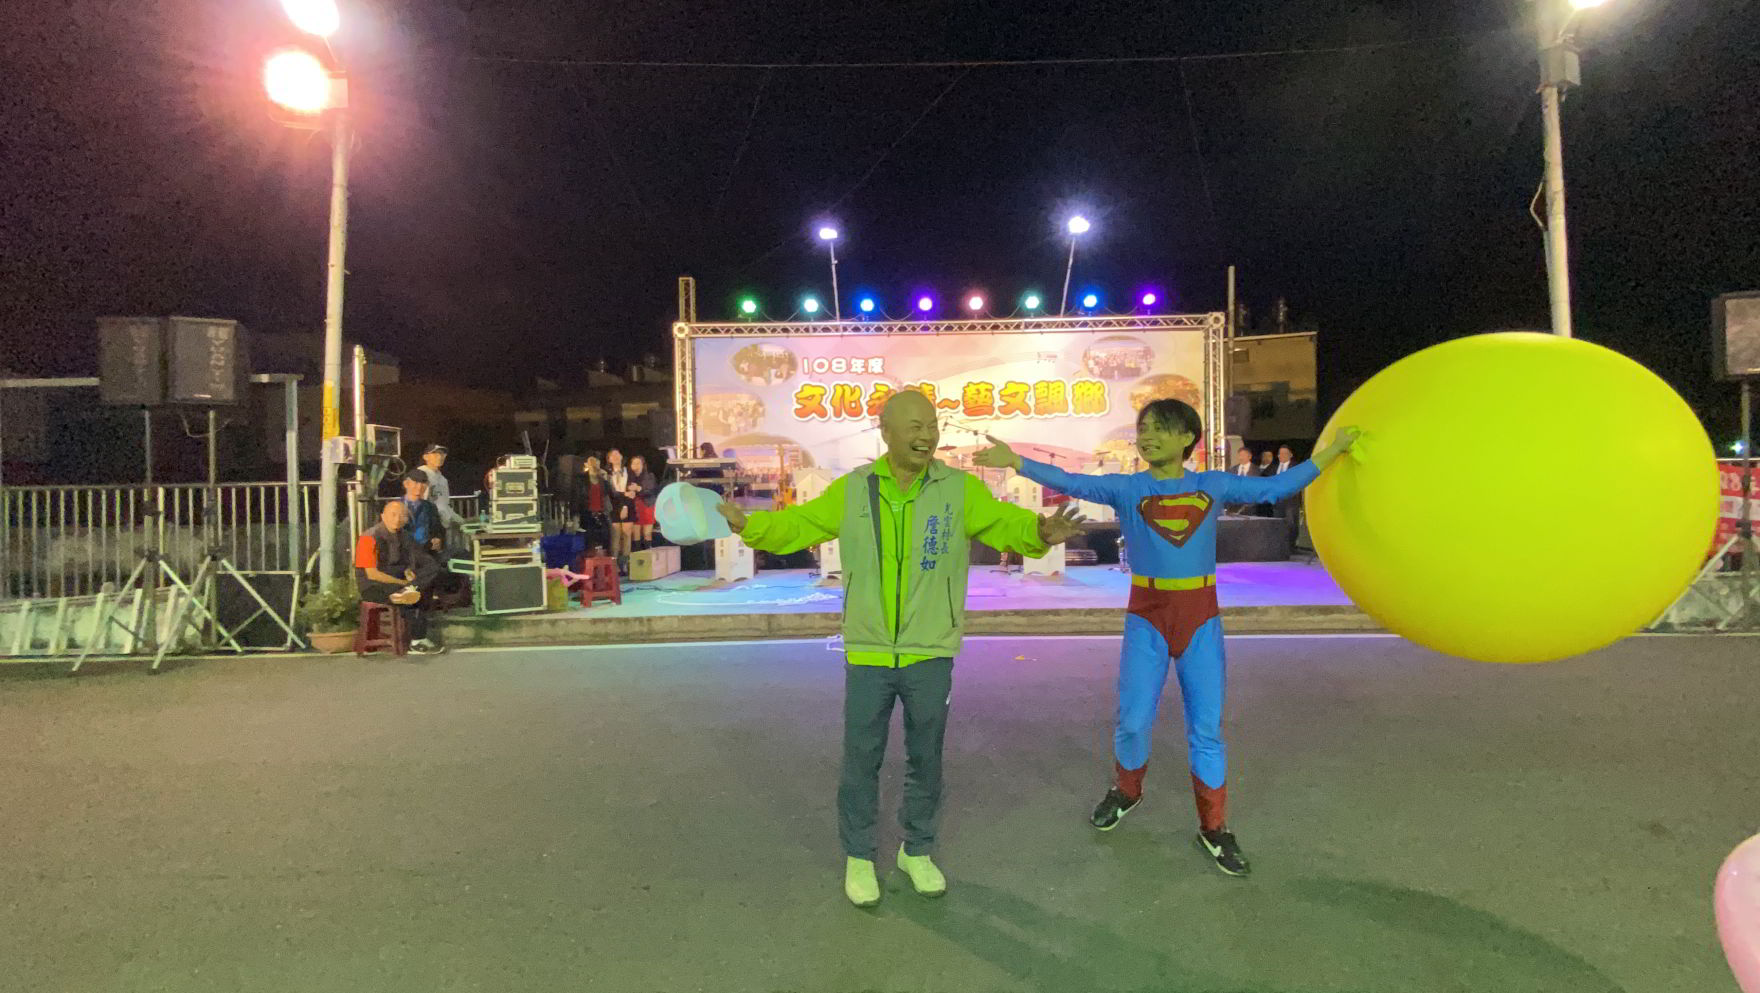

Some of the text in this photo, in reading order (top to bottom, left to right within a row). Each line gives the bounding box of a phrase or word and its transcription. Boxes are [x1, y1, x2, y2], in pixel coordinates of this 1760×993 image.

[803, 356, 885, 376] 108年度
[920, 515, 940, 571] 詹德如
